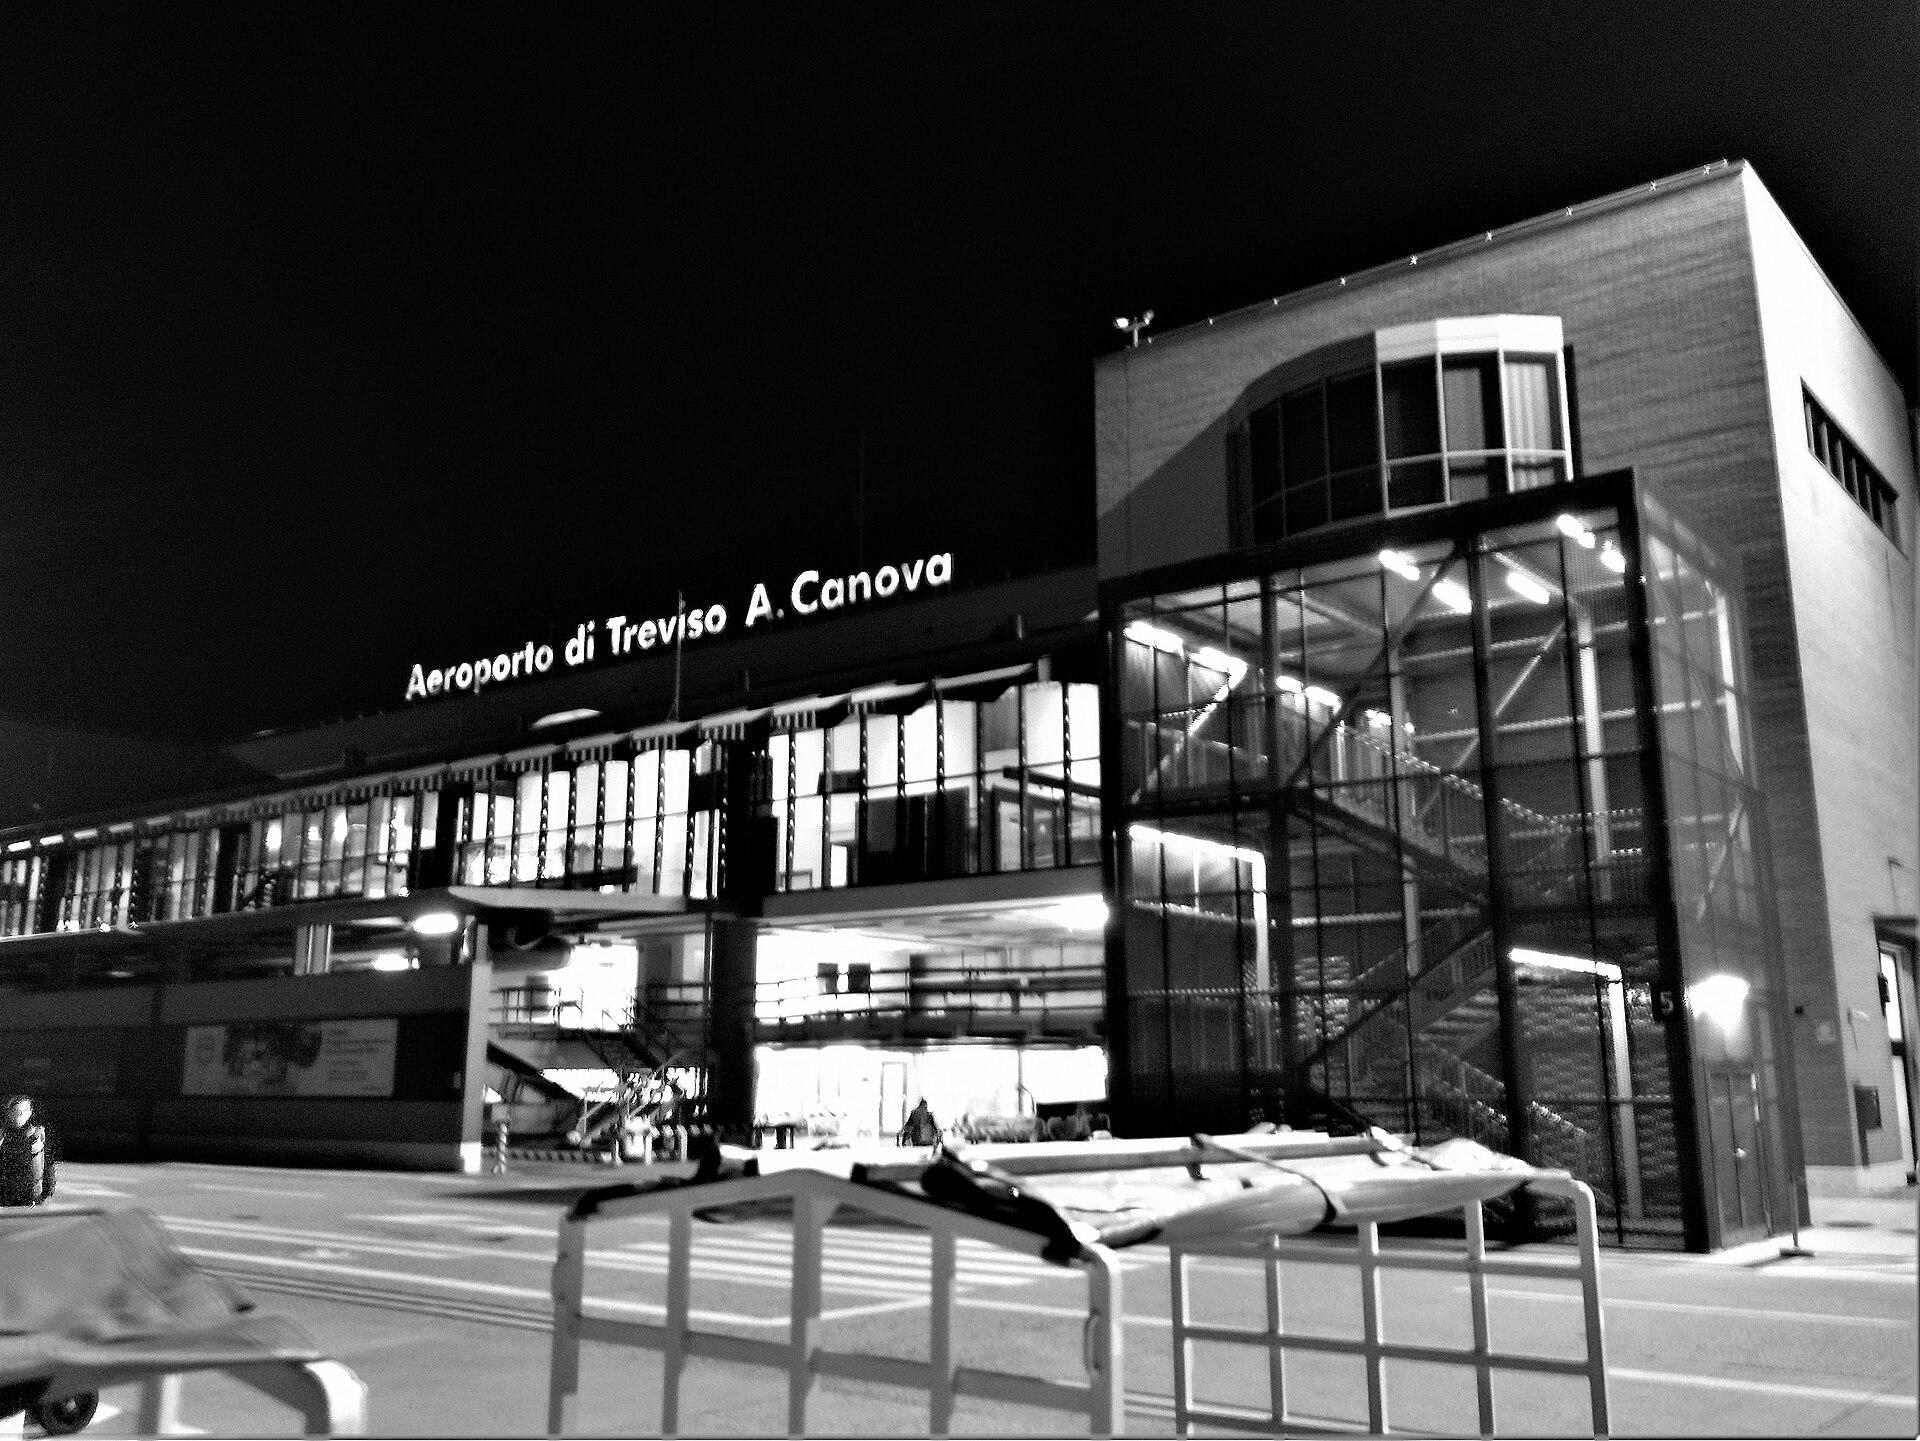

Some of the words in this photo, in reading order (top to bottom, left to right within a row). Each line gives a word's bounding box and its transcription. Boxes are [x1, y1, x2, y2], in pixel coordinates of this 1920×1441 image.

[404, 640, 554, 701] Aeroporto
[564, 619, 596, 667] di
[605, 599, 728, 656] Treviso
[744, 582, 785, 628] A.
[790, 552, 952, 615] Canova
[1660, 989, 1674, 1015] 5
